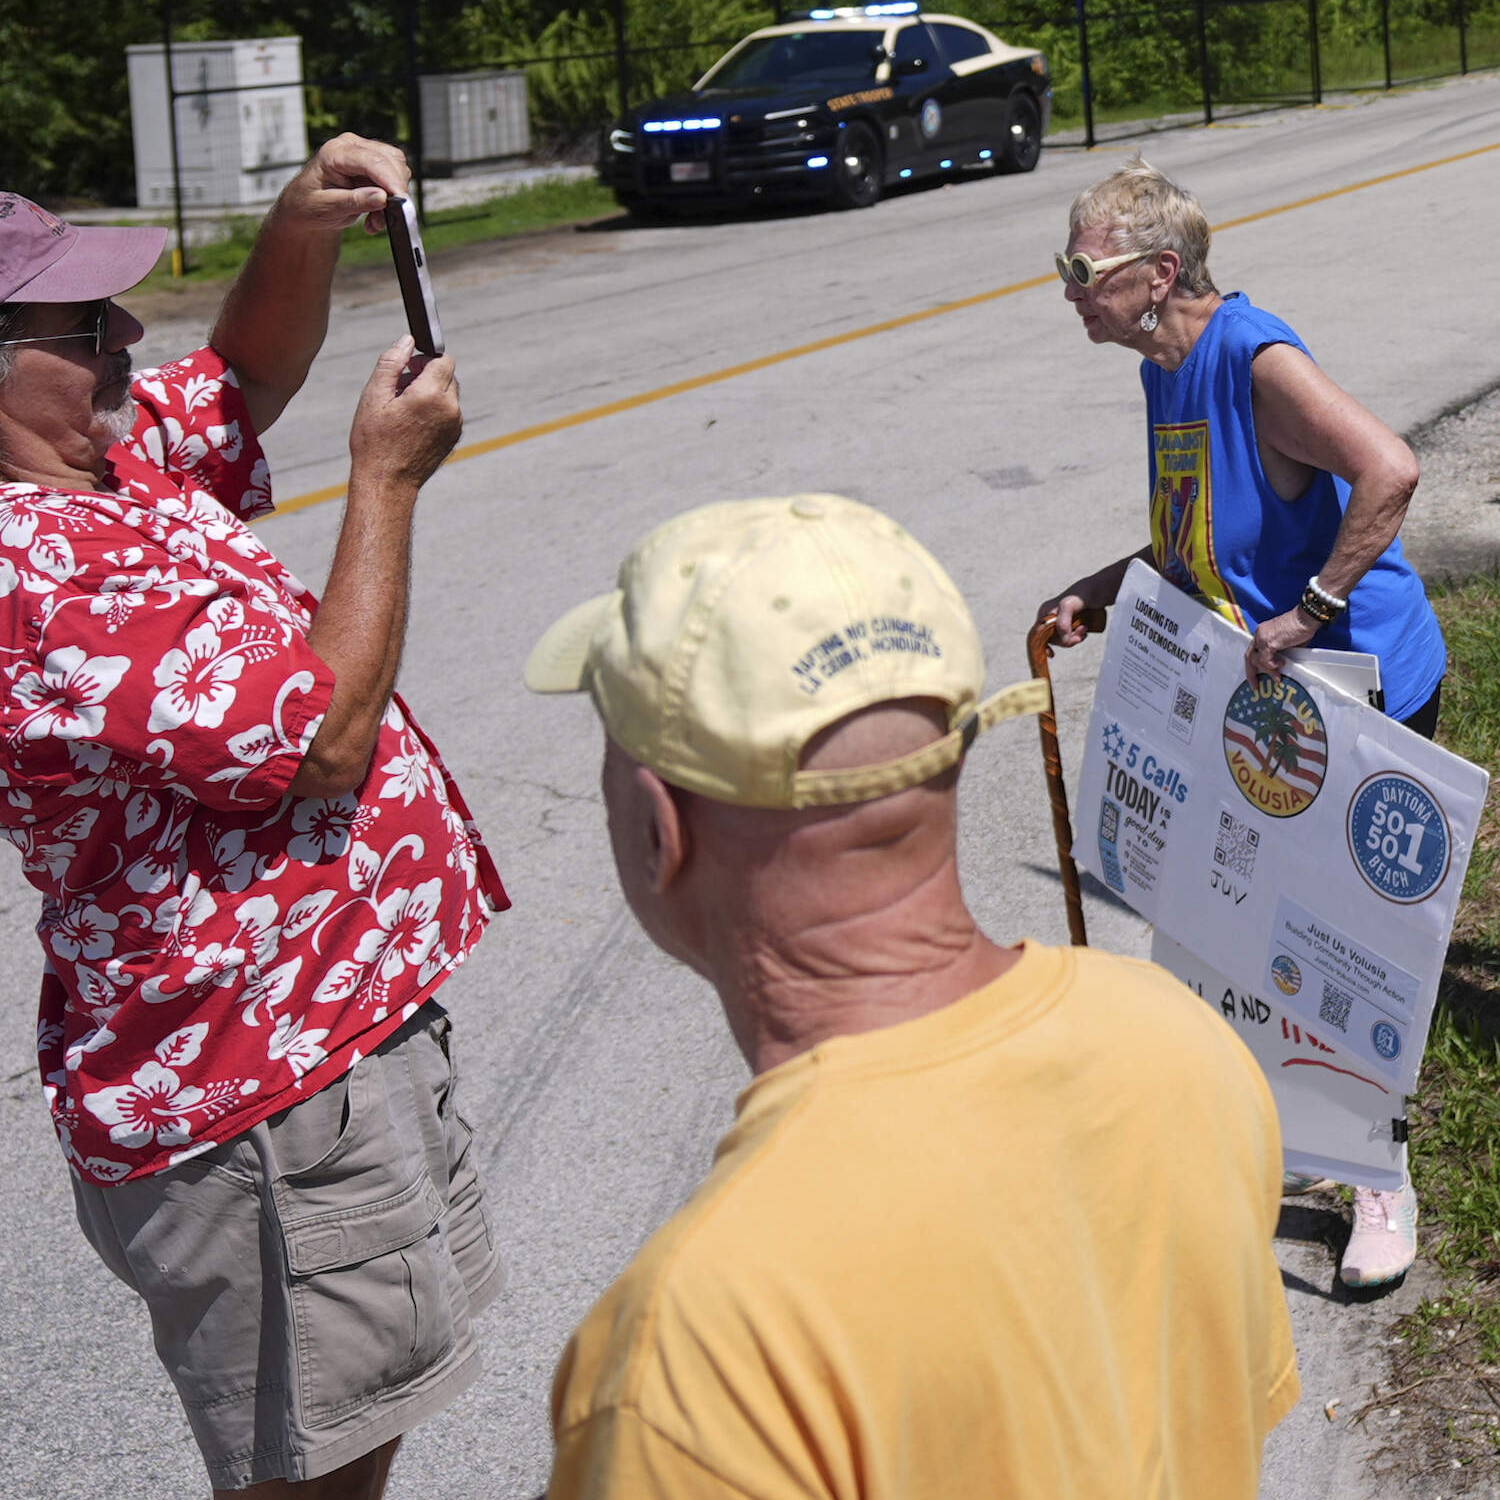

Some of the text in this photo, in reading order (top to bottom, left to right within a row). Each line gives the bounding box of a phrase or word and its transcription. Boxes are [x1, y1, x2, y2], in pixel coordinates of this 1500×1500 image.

[1135, 598, 1180, 636] LOOKING FOR
[1131, 616, 1149, 636] LOST
[1148, 628, 1190, 664] DEMOCRACY
[1251, 678, 1319, 735] JUST US
[1126, 743, 1140, 768] 5
[1107, 759, 1161, 825] TODAY
[1232, 750, 1304, 810] VOLUSIA
[1371, 800, 1405, 836] 50
[1382, 787, 1434, 824] DAYTONA
[1366, 824, 1399, 860] 50
[1368, 855, 1409, 888] BEACH
[1285, 920, 1313, 947] Building
[1313, 940, 1352, 972] Community
[1353, 965, 1382, 991] Through
[1382, 985, 1406, 1005] Action
[1307, 923, 1387, 981] Just Us Volusia
[1221, 988, 1271, 1024] AND
